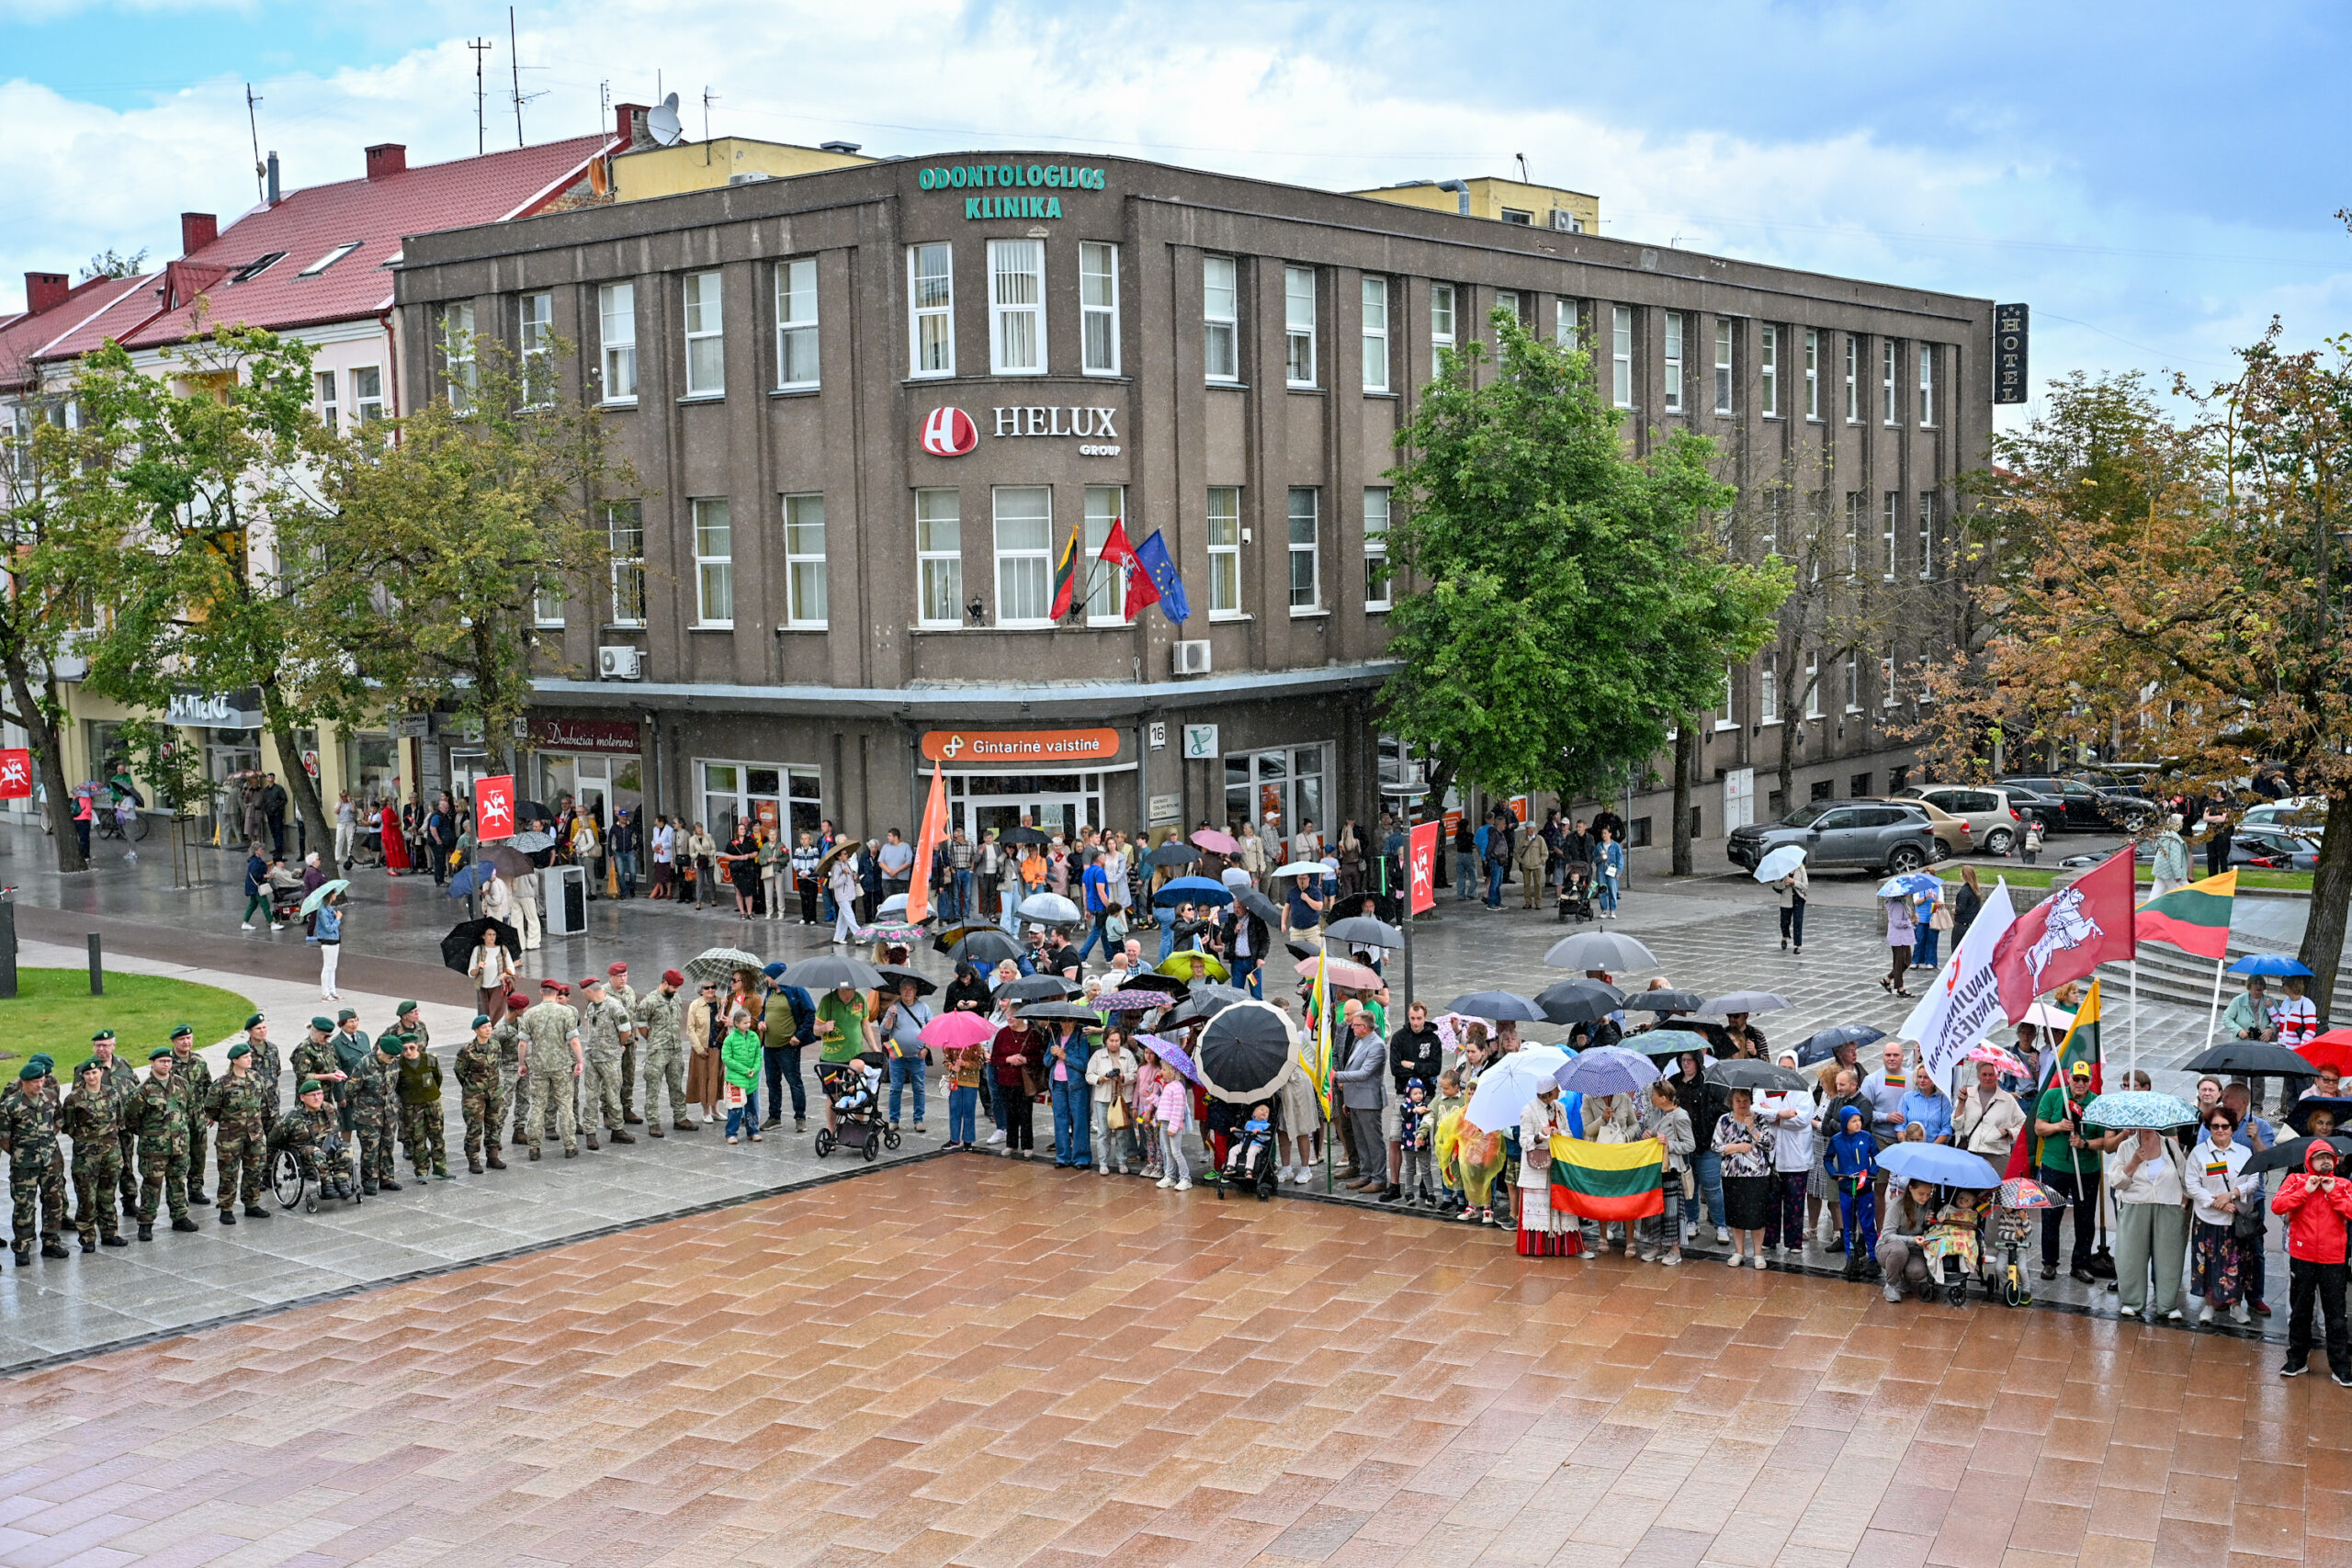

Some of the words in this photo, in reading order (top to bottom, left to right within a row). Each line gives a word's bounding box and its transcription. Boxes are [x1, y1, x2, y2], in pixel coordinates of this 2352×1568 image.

[920, 165, 1105, 190] ODONTOLOGIJOS
[966, 197, 1062, 219] KLINIKA
[2001, 318, 2021, 401] HOTEL
[993, 407, 1118, 437] HELUX
[1079, 445, 1121, 456] GROUP
[515, 721, 526, 733] 16
[547, 722, 594, 746] Drabužiai
[596, 733, 634, 748] moterims
[1151, 727, 1164, 740] 16
[973, 739, 1041, 753] Gintarinė
[1046, 738, 1100, 751] vaistinė
